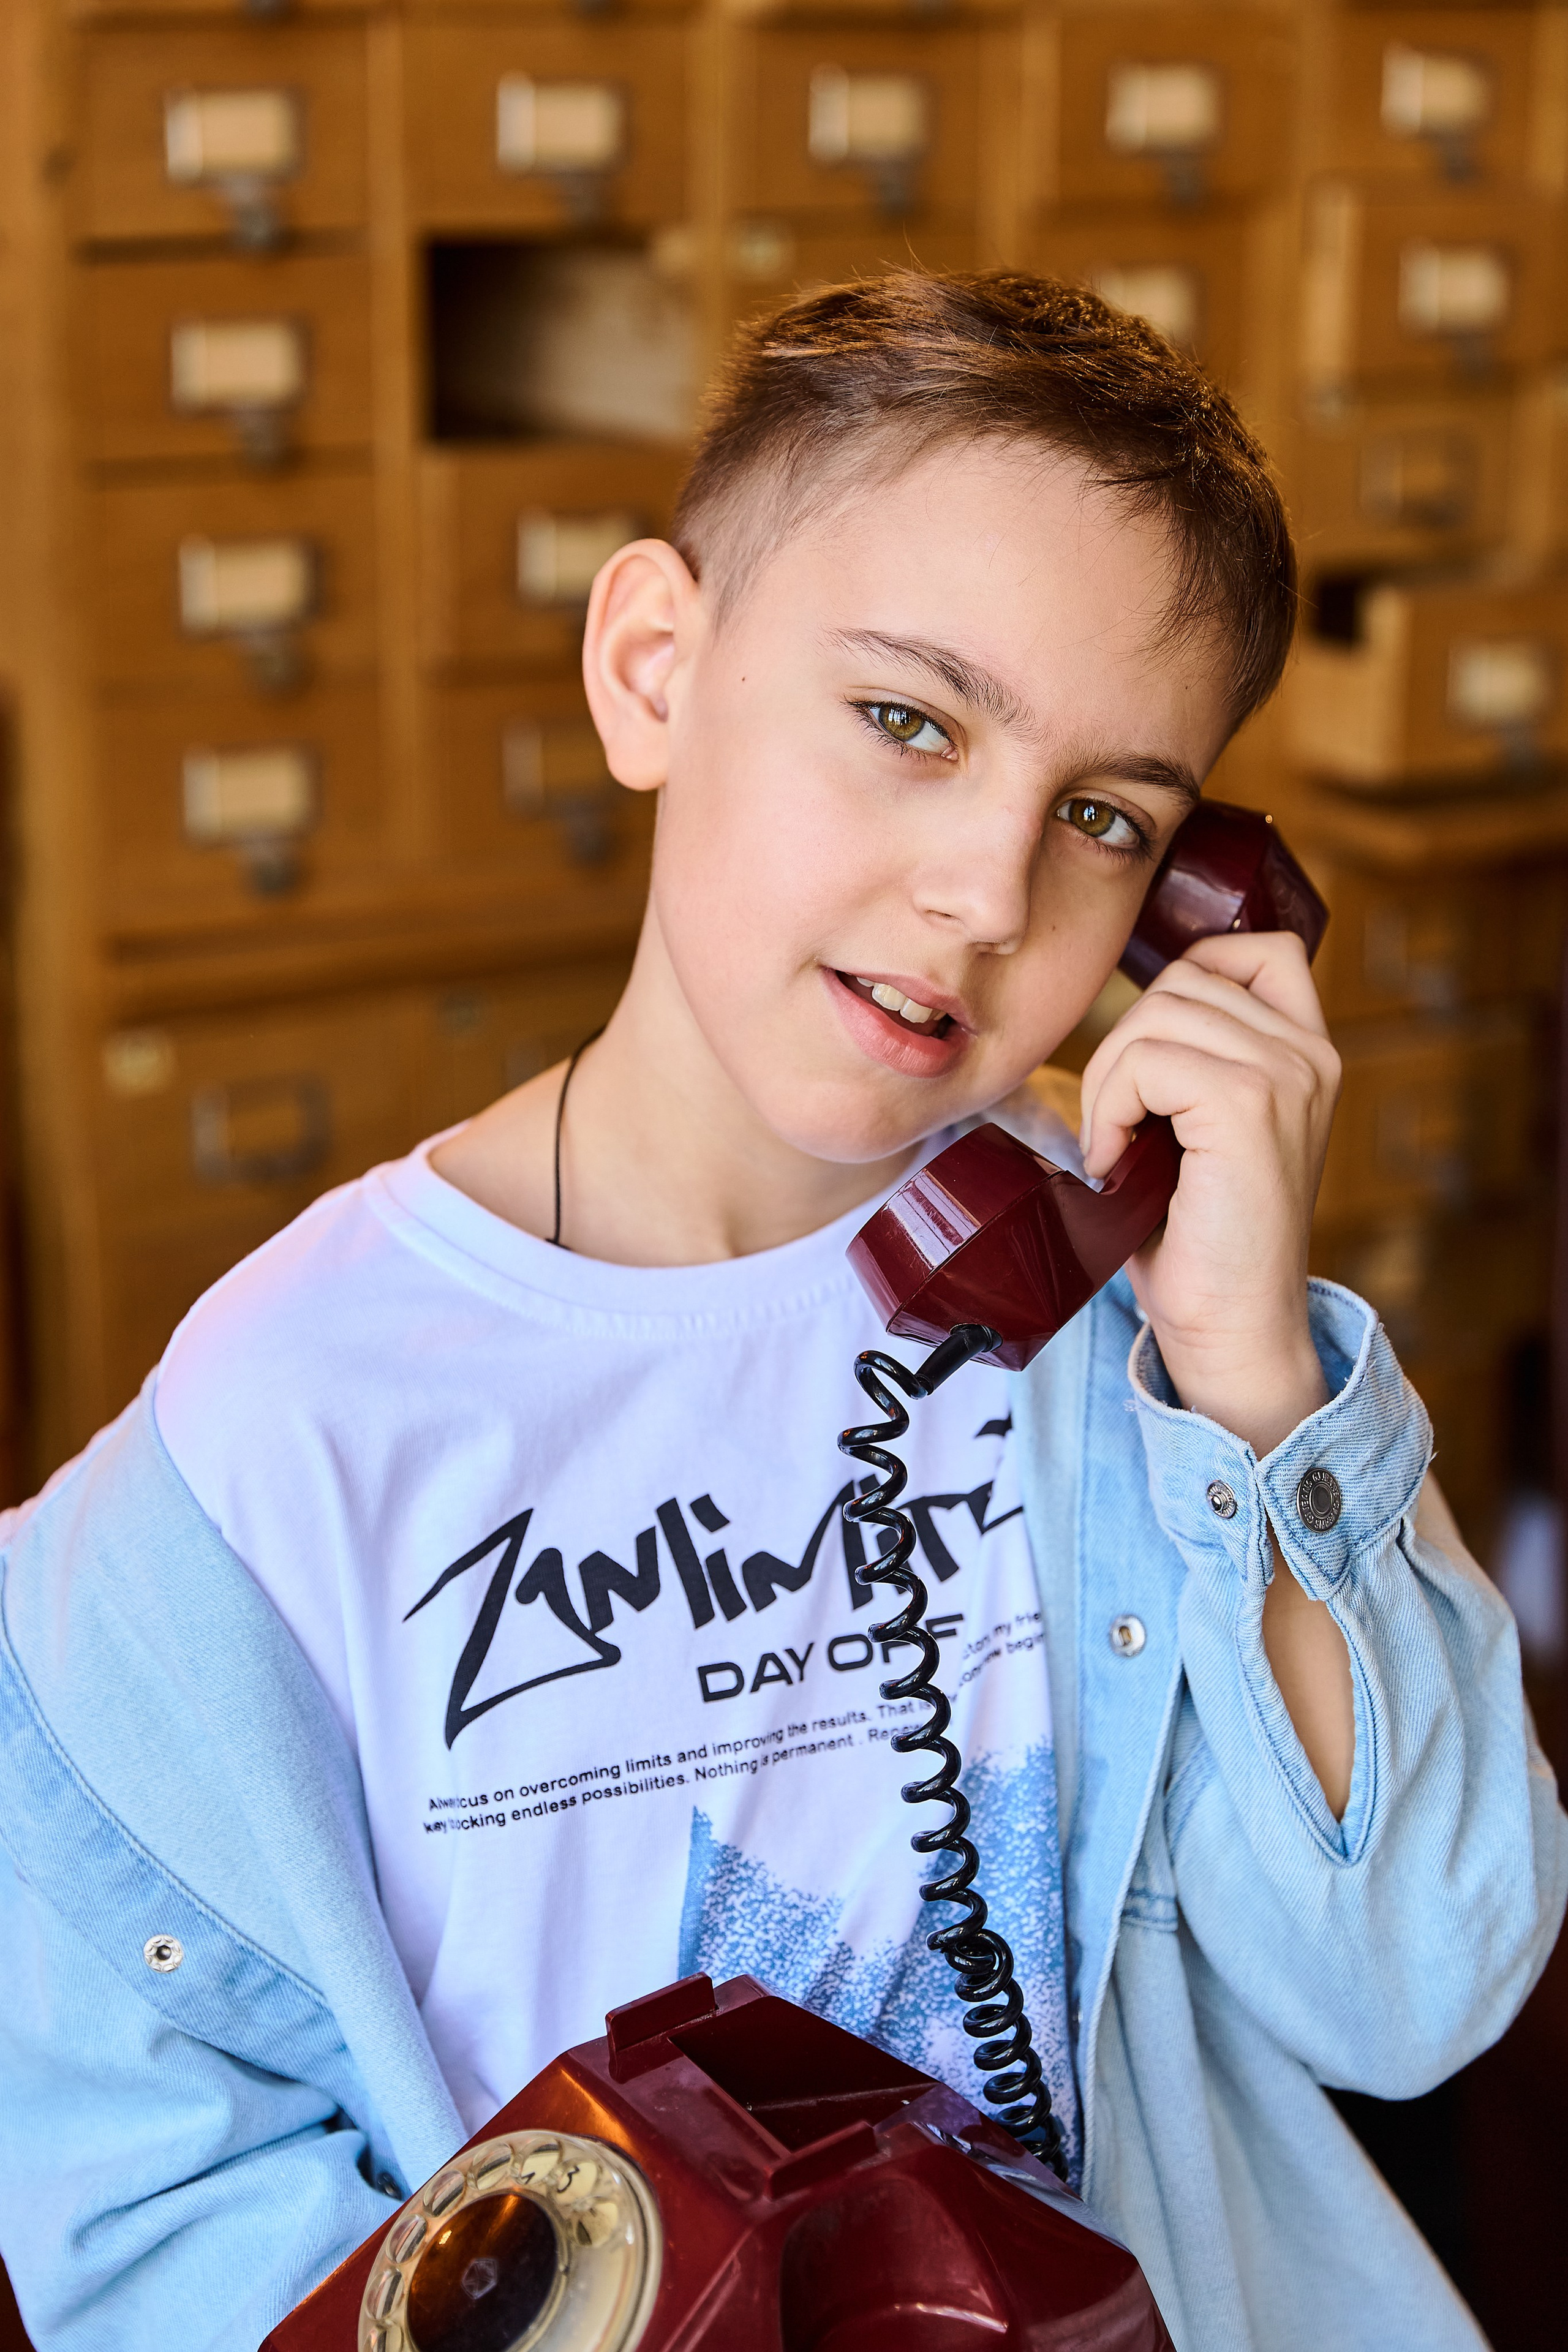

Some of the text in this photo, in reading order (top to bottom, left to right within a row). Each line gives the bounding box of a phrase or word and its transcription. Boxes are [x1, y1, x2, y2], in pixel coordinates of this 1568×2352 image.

[698, 1642, 815, 1703] DAY
[494, 1788, 514, 1801] on
[520, 1765, 620, 1796] overcoming
[625, 1754, 673, 1774] limits
[677, 1744, 708, 1763] and
[712, 1728, 784, 1757] improving
[788, 1722, 809, 1737] the
[876, 1701, 915, 1719] That
[511, 1799, 578, 1821] endless
[582, 1775, 690, 1805] possibilities.
[695, 1758, 759, 1782] Nothing
[772, 1734, 853, 1766] permanent
